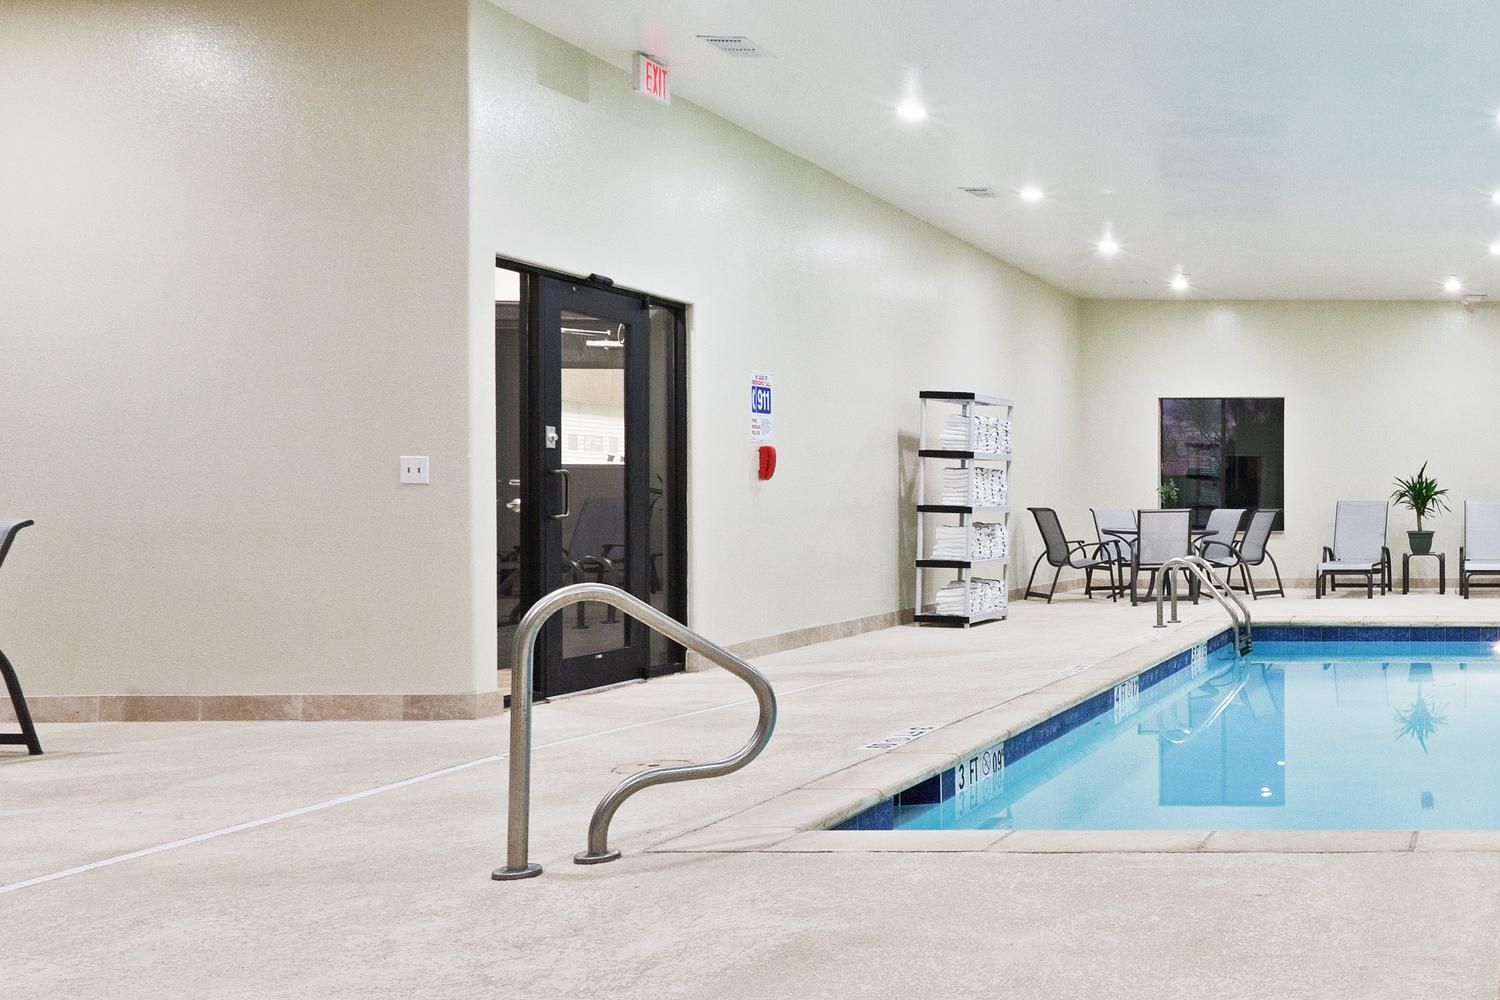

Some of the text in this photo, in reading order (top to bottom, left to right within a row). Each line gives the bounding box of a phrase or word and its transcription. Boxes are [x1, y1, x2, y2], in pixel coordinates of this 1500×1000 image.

[645, 60, 668, 99] EXIT
[757, 388, 770, 410] 911
[959, 764, 965, 790] 3
[970, 756, 979, 784] FT
